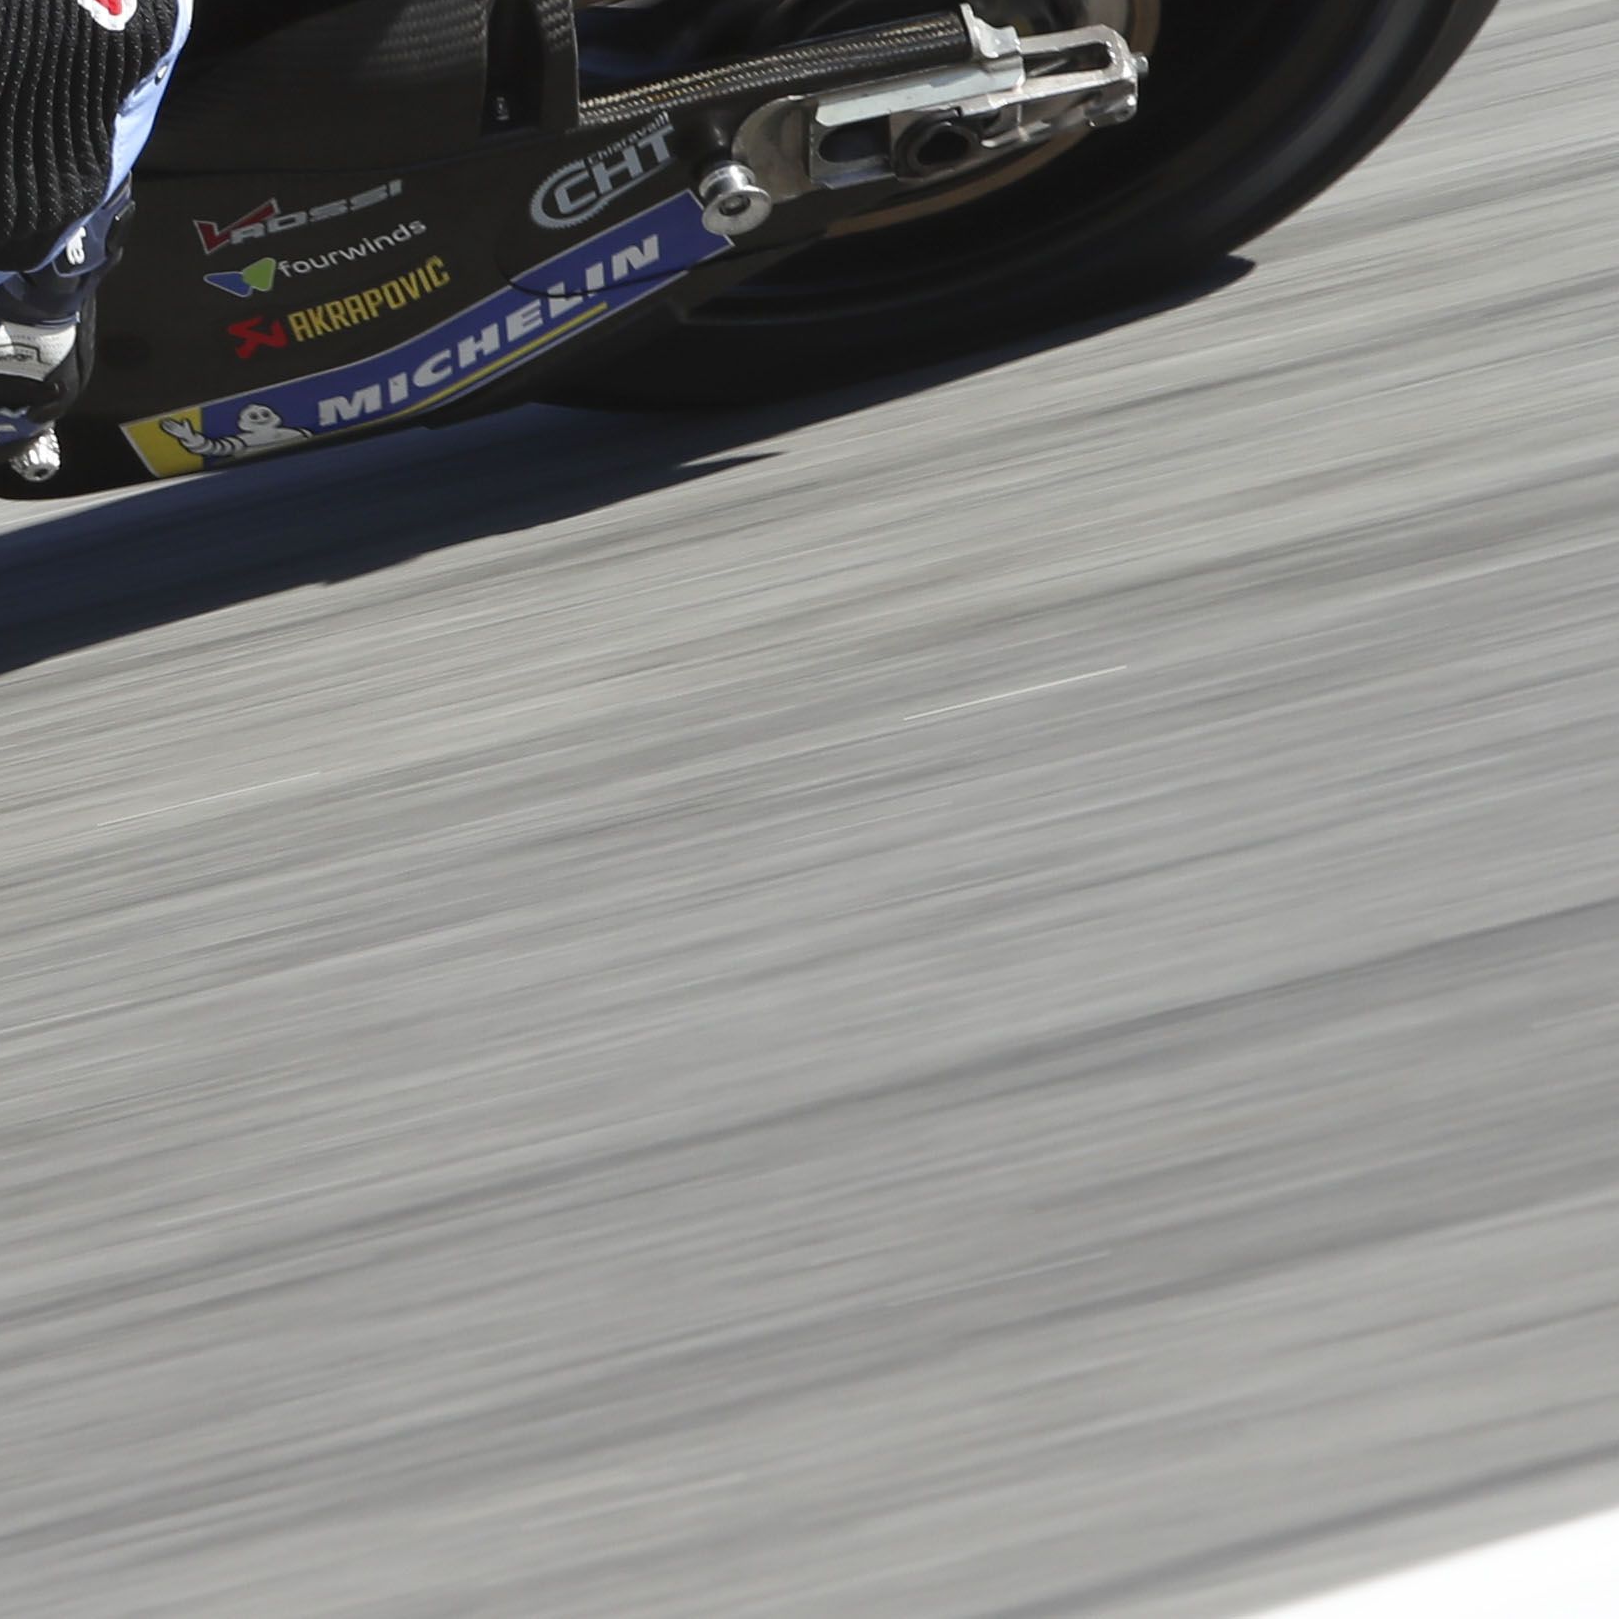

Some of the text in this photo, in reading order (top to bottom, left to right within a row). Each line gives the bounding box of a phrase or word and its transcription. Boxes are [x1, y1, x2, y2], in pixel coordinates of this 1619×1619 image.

[552, 124, 675, 210] CHT
[277, 218, 428, 279] fourwinds
[318, 233, 661, 427] MICHELIN
